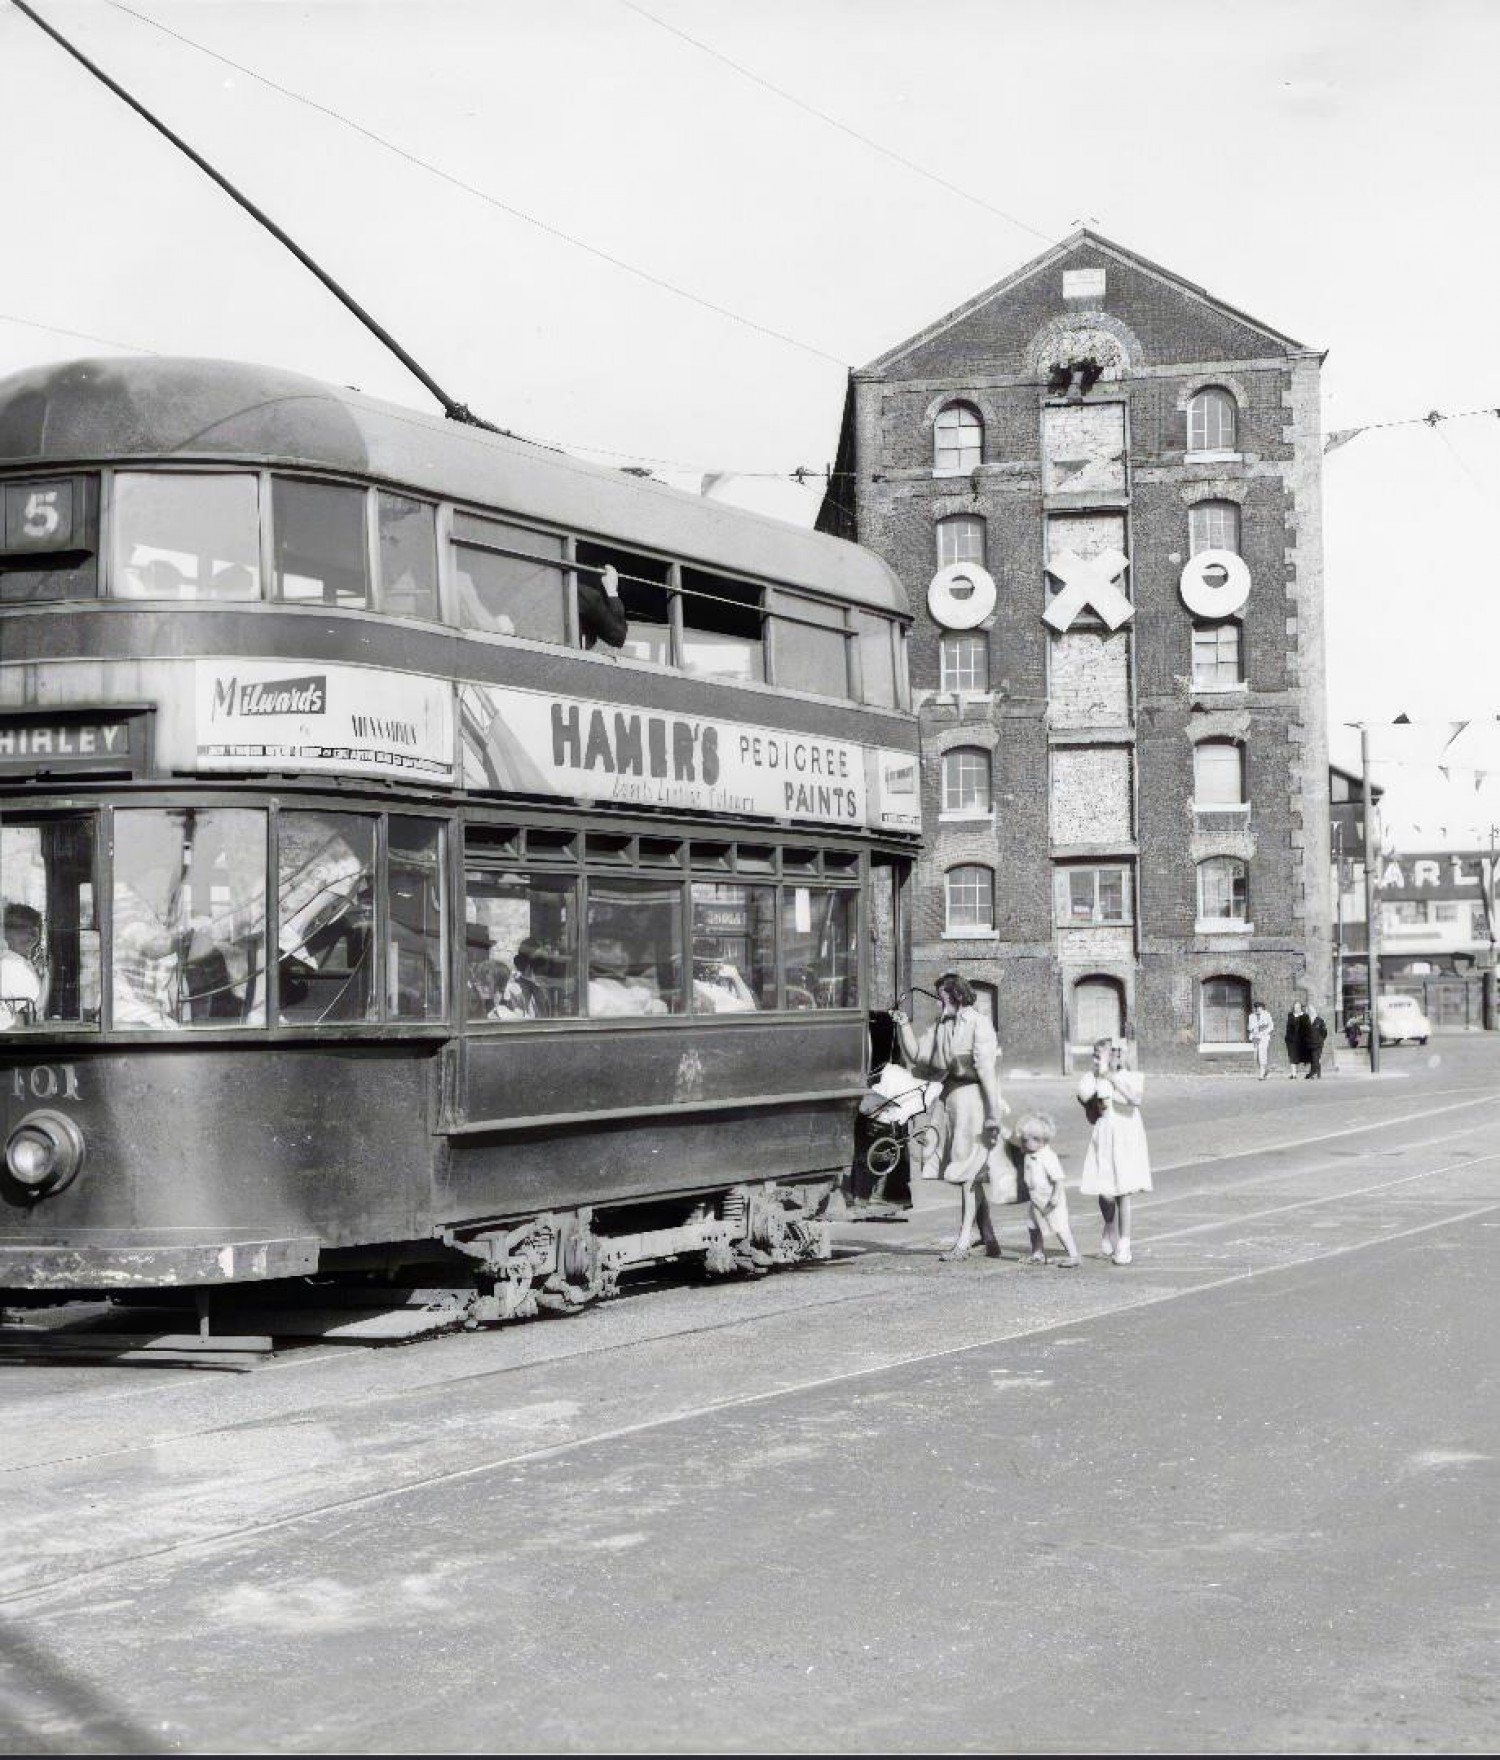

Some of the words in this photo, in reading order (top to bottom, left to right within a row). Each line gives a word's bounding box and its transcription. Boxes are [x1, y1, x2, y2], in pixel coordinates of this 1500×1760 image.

[23, 491, 58, 537] 5
[927, 549, 1251, 632] OXO
[212, 676, 322, 724] Milwards
[739, 735, 848, 778] PEDIGREE
[784, 781, 857, 818] PAINTS
